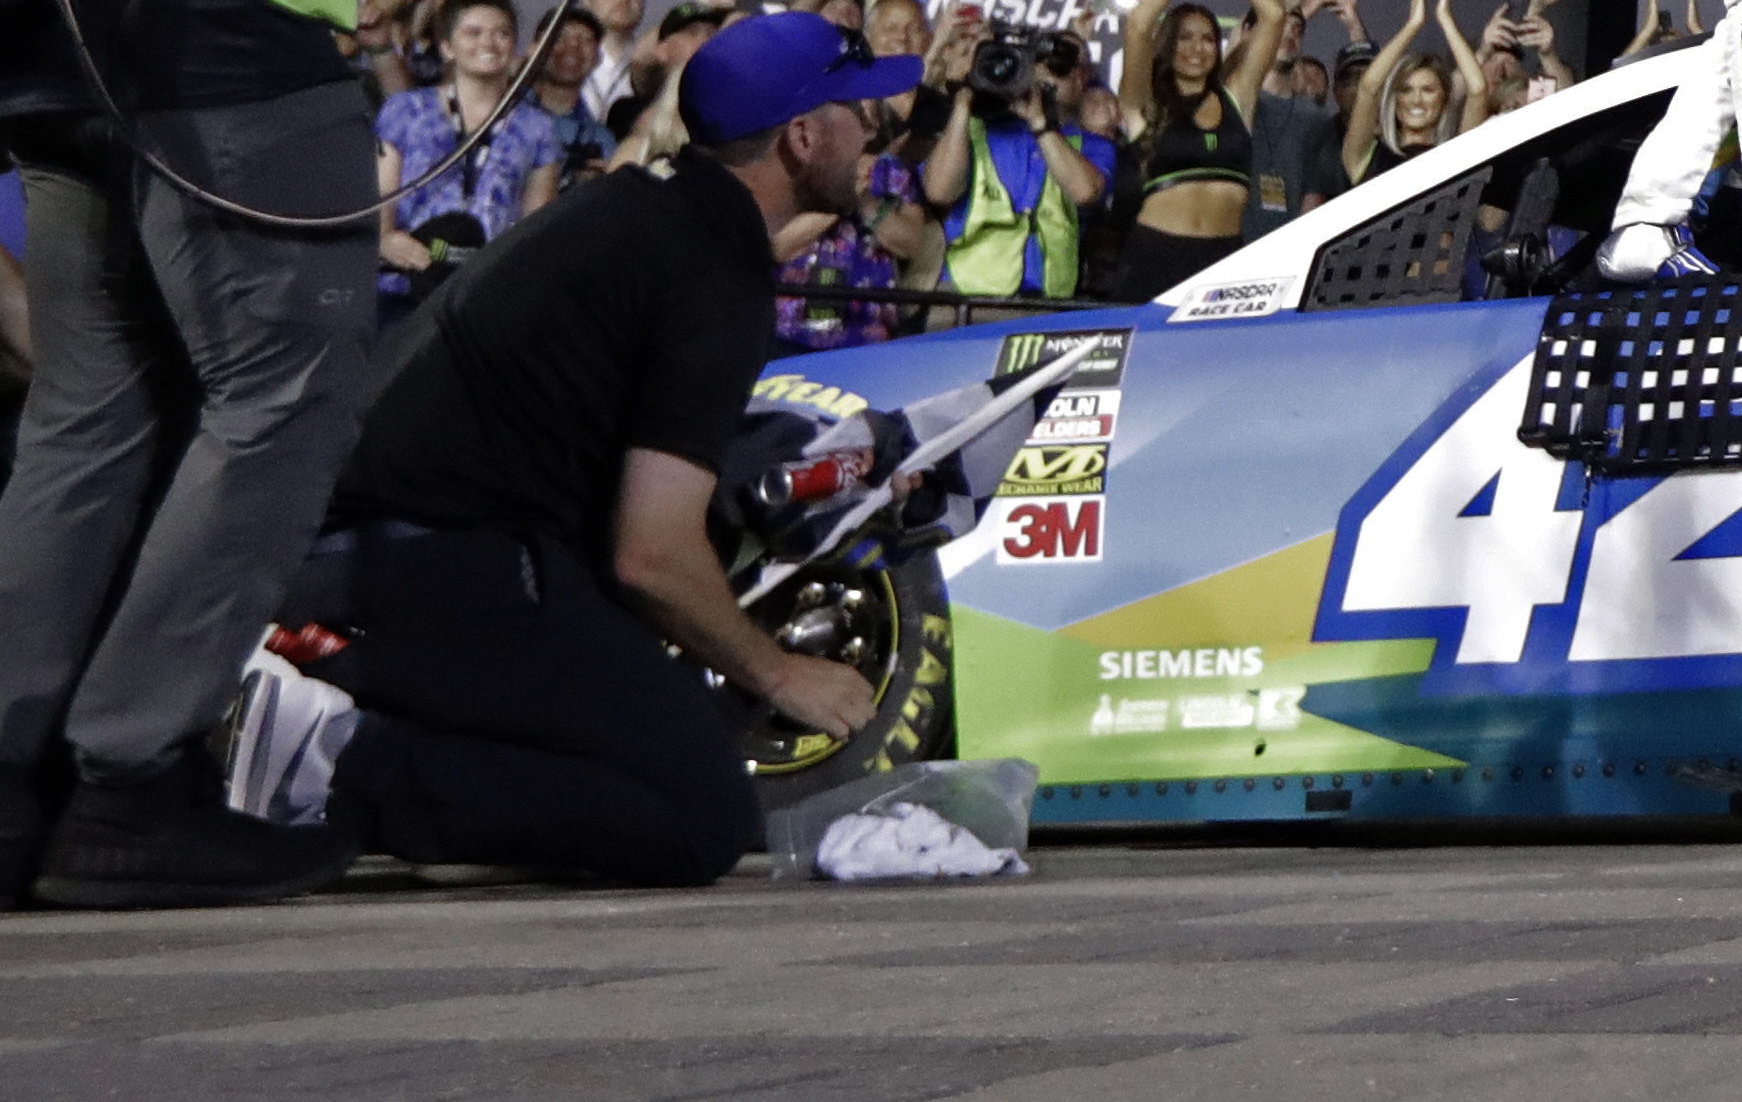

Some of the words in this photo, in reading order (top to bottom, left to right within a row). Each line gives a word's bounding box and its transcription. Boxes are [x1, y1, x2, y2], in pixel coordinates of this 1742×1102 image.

[1188, 304, 1230, 316] RACE
[1233, 301, 1267, 313] CAR
[1033, 419, 1102, 439] ELDERS
[1003, 501, 1099, 558] 3M
[1100, 647, 1263, 680] SIEMENS
